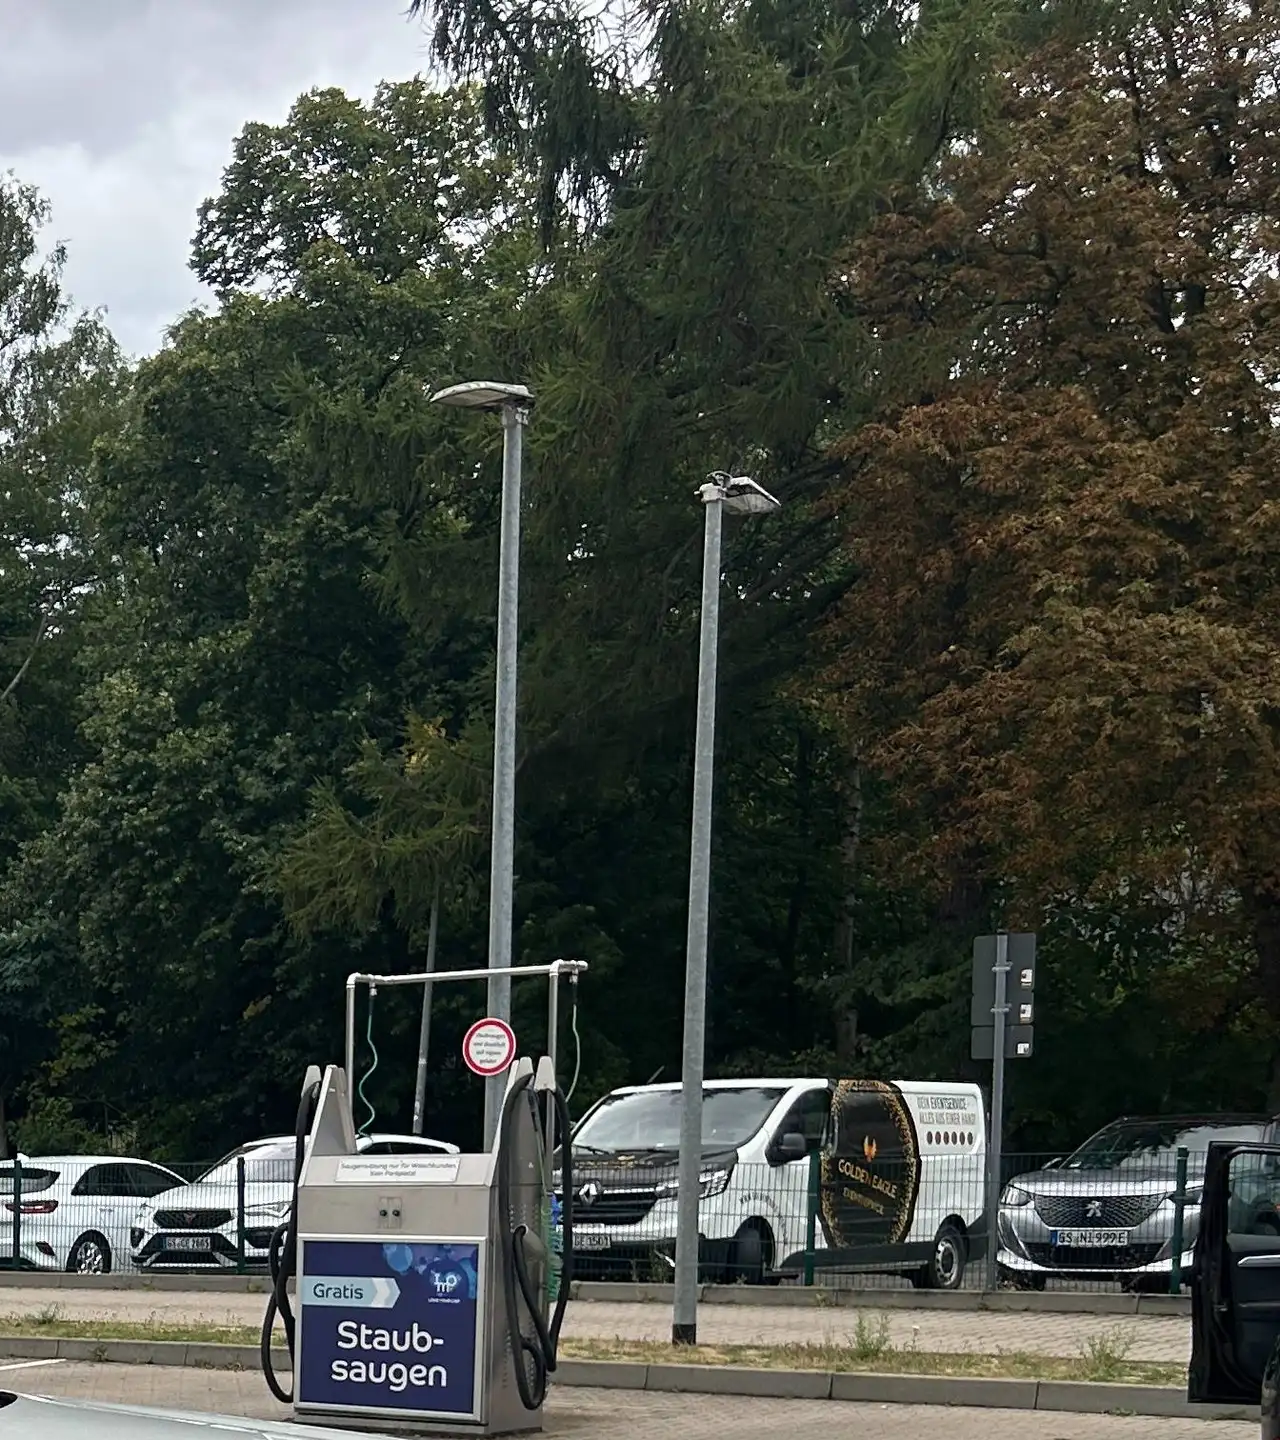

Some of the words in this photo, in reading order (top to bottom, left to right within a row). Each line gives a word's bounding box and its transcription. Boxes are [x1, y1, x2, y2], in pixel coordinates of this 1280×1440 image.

[838, 1159, 871, 1186] GOLDEN
[872, 1175, 897, 1199] EAGLE
[313, 1283, 364, 1300] Gratis
[337, 1321, 444, 1352] Staub-
[331, 1359, 448, 1392] saugen
